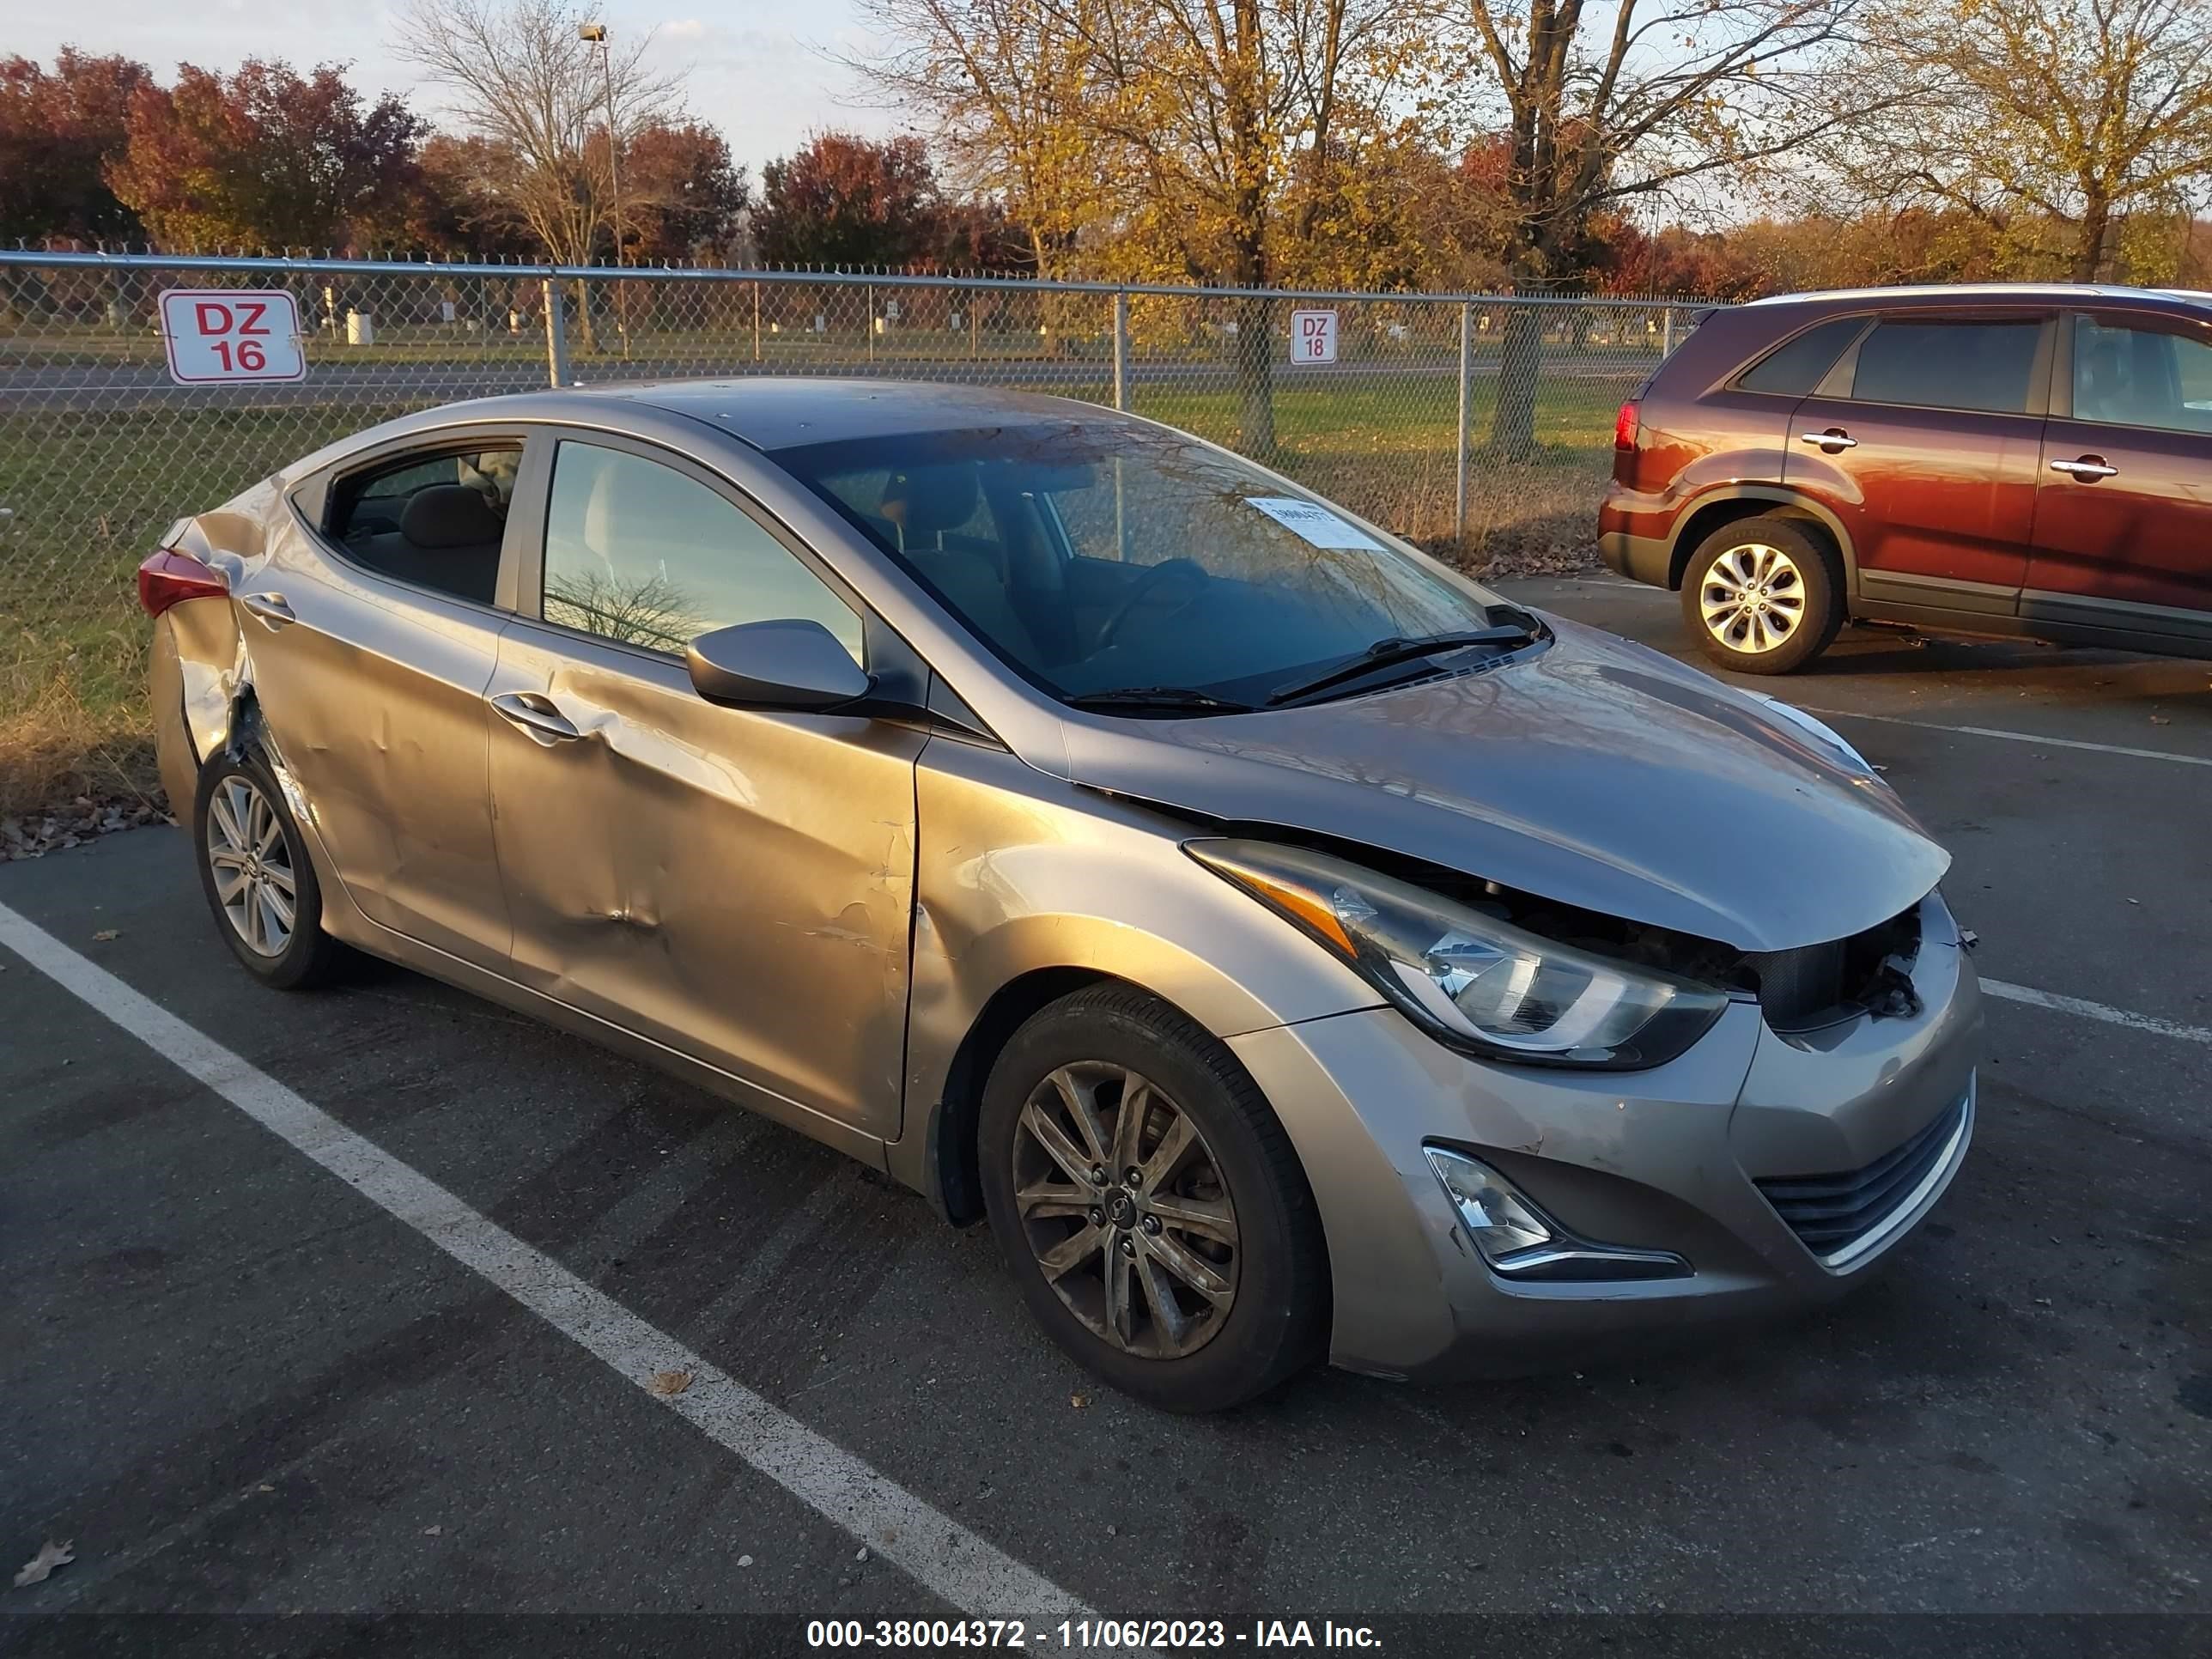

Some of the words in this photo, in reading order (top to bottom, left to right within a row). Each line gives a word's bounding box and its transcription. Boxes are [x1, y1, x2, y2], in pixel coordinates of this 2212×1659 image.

[195, 302, 270, 336] DZ
[1304, 318, 1328, 337] DZ
[210, 340, 266, 372] 16
[1305, 338, 1323, 356] 18
